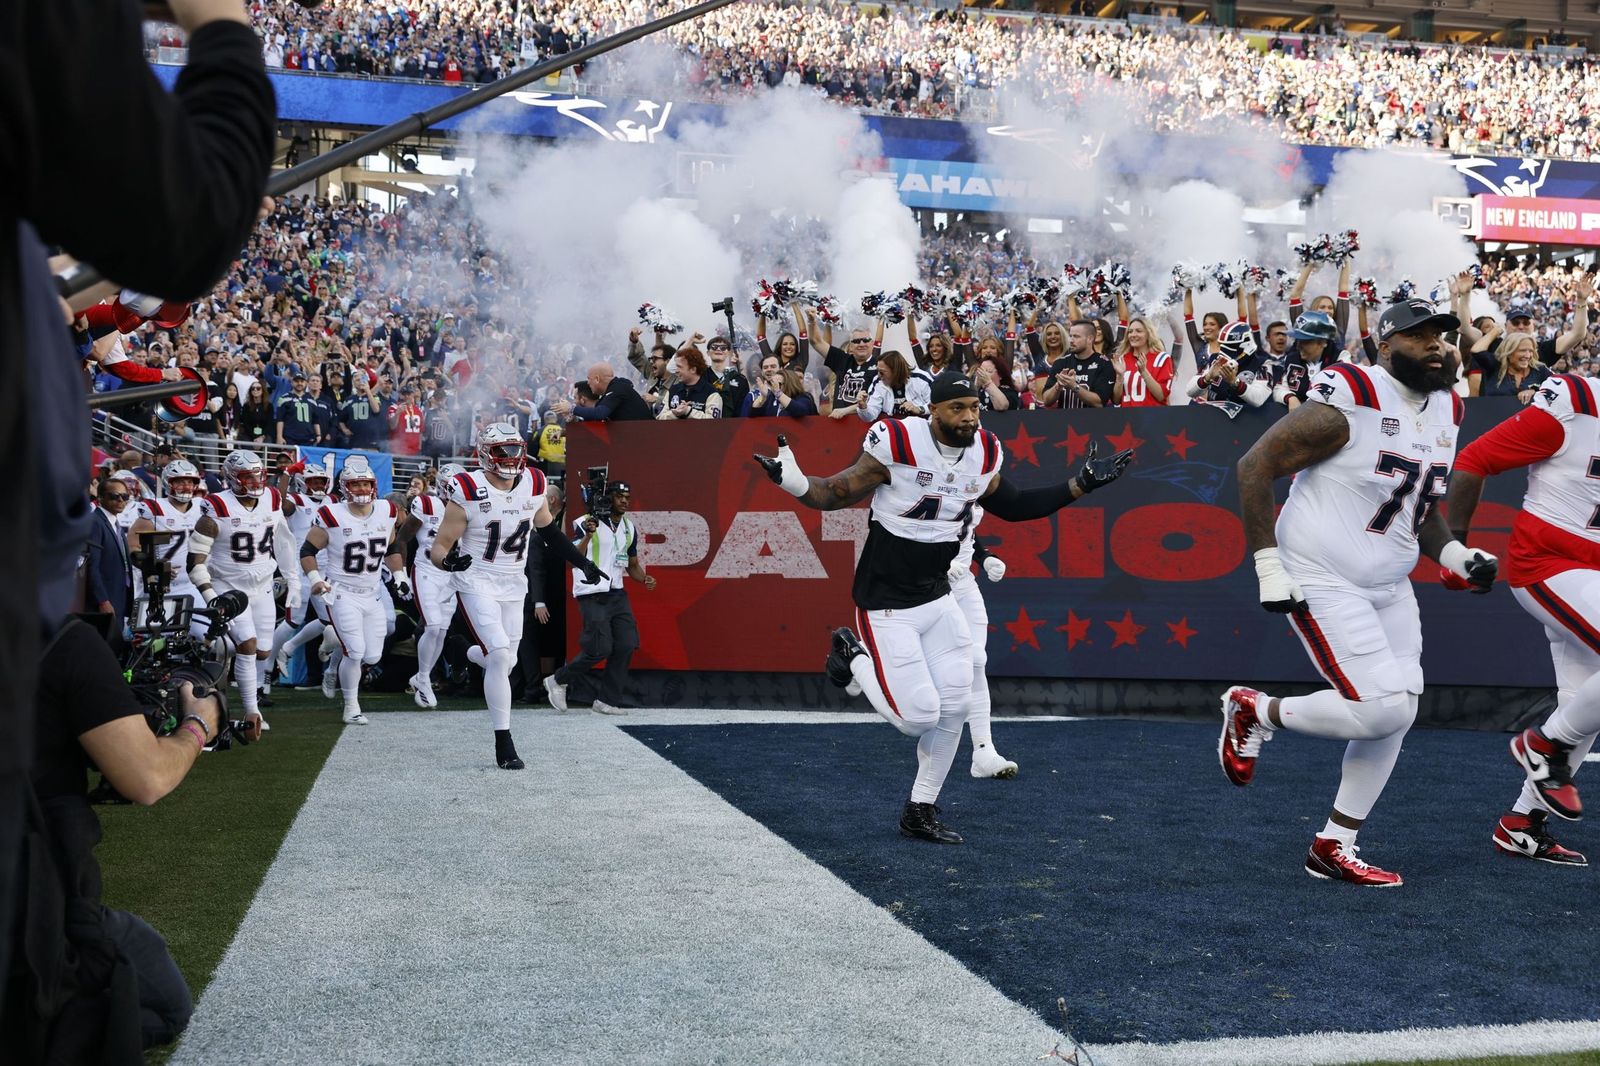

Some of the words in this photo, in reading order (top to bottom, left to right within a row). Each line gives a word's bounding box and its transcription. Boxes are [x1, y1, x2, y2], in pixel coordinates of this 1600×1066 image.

[1486, 208, 1516, 227] NEW
[1518, 208, 1577, 230] ENGLAND
[1122, 370, 1147, 402] 10
[294, 402, 310, 423] 11
[351, 402, 370, 420] 10
[431, 421, 448, 440] 10
[230, 525, 276, 563] 94
[482, 518, 531, 563] 14
[342, 536, 388, 574] 65
